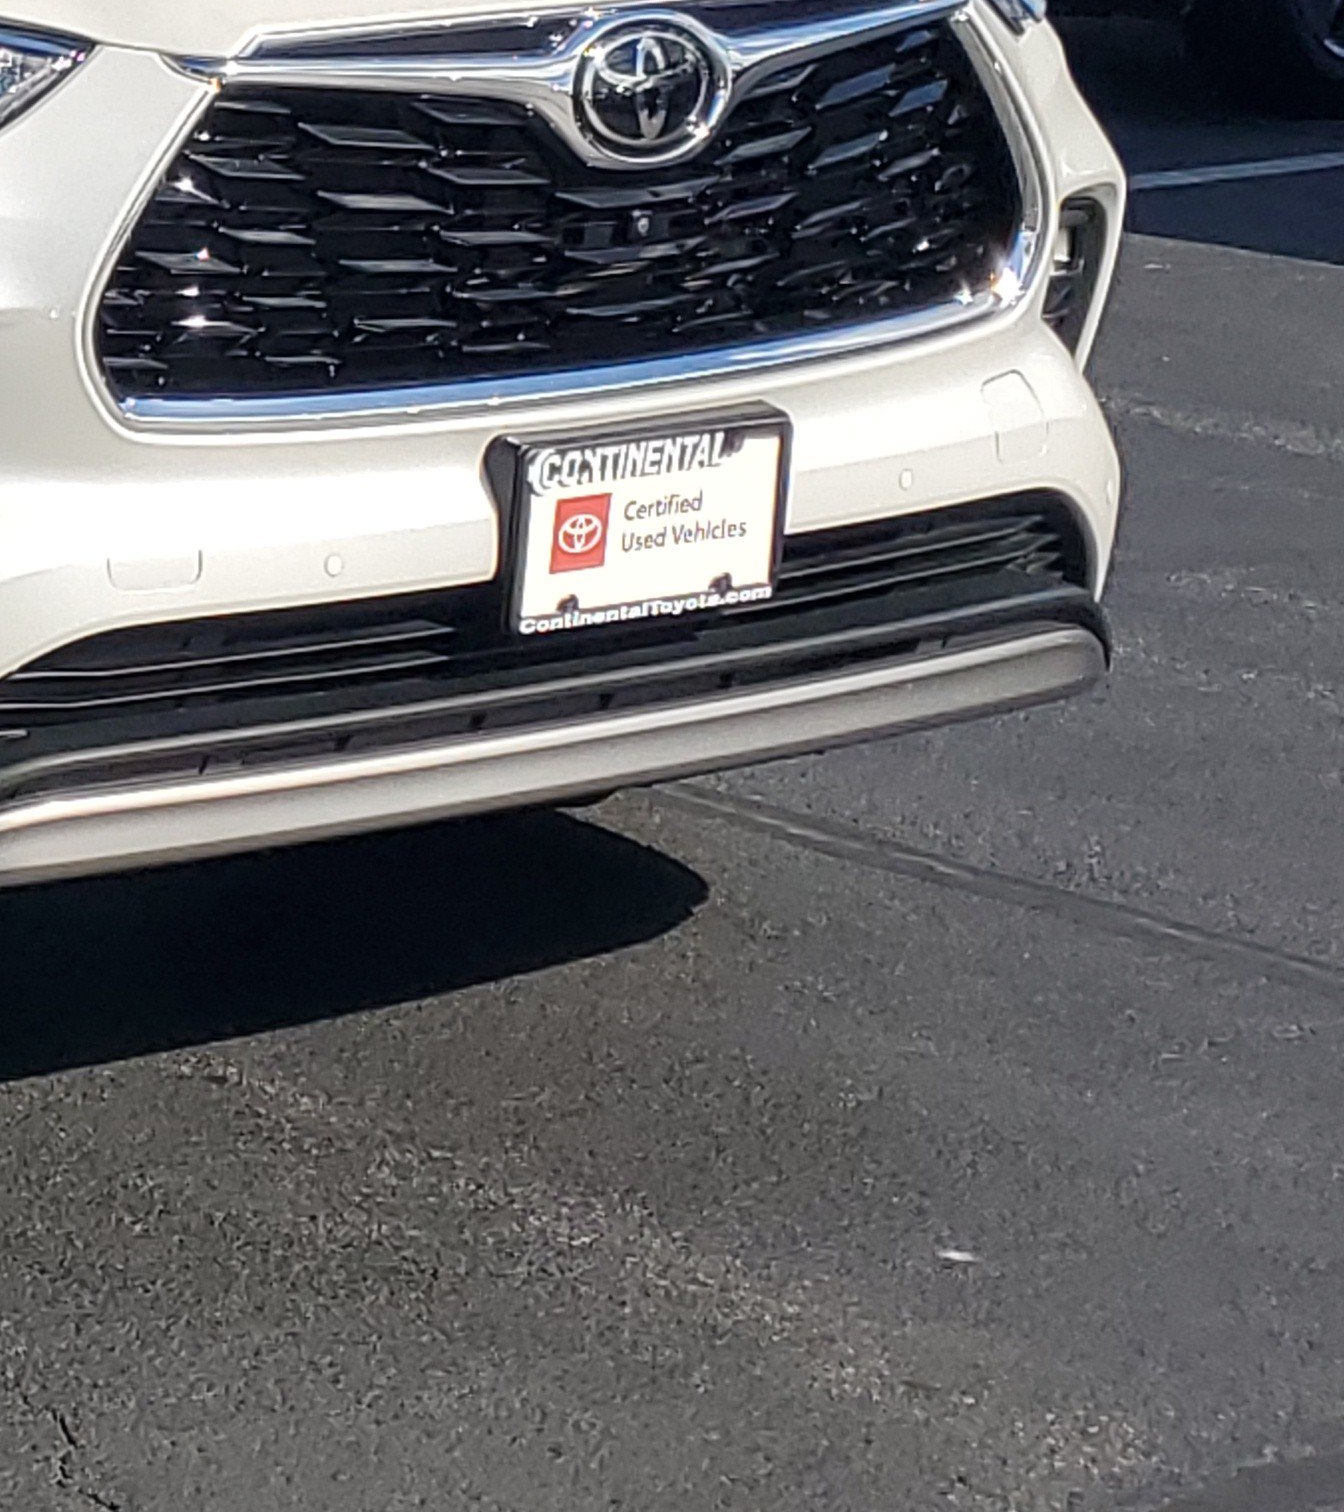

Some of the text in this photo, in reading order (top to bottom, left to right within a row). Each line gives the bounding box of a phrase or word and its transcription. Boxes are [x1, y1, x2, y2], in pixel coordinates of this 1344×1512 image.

[539, 430, 725, 488] CONTINENTAL
[623, 489, 703, 521] Certified
[621, 518, 747, 553] Used Vehicles
[518, 585, 773, 635] ContinentalToyota.com
